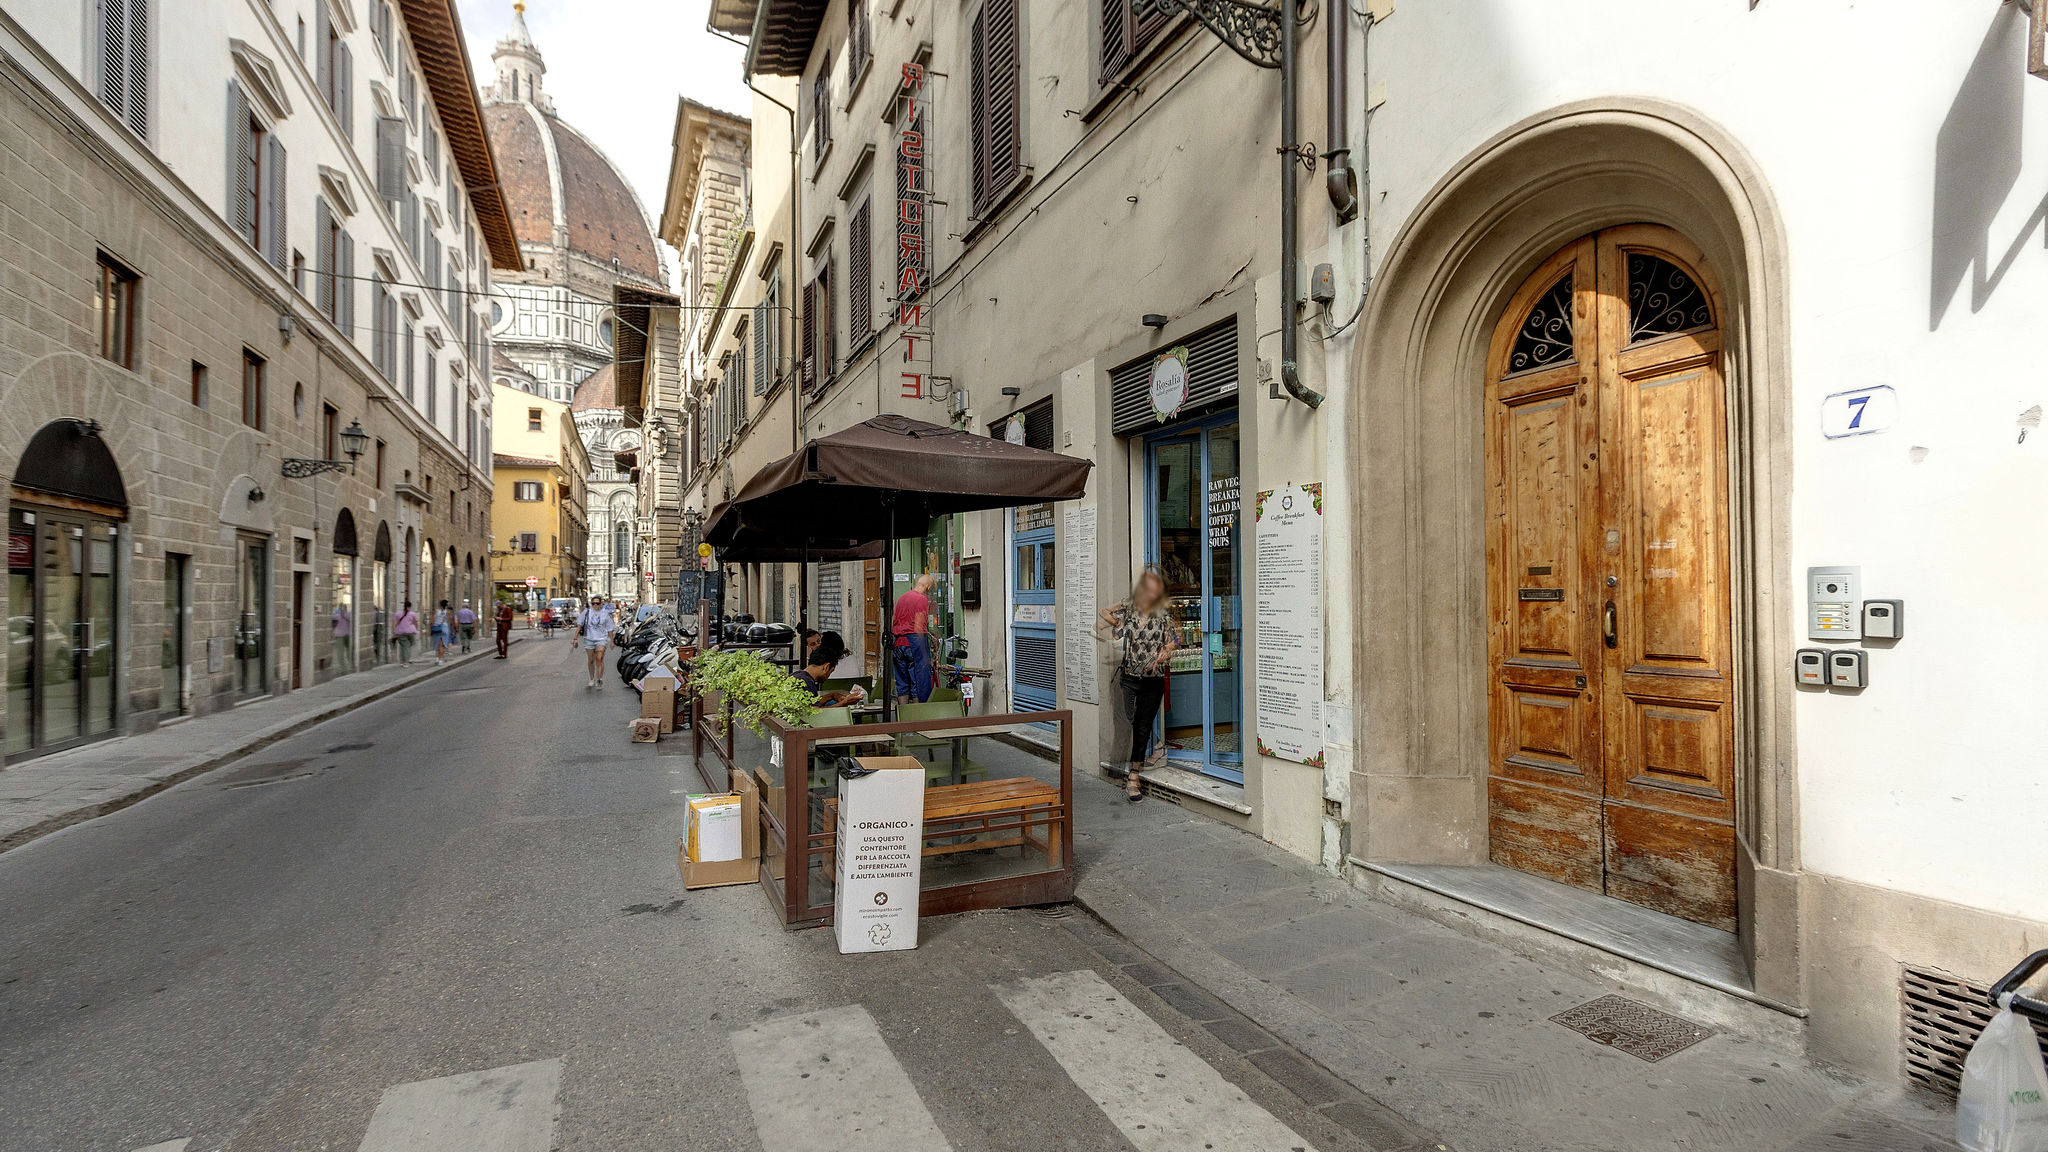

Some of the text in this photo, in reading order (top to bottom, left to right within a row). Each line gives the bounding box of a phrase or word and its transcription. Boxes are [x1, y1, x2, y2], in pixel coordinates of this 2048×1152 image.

[1156, 374, 1181, 390] Rosalia
[1848, 396, 1870, 429] 7
[1208, 476, 1240, 492] RAW VEG
[1208, 502, 1230, 514] SALAD
[1209, 514, 1234, 526] COFFEE
[1209, 526, 1229, 537] WRAP
[1209, 537, 1229, 547] SOUPS
[859, 821, 908, 829] ORGANICO
[878, 836, 904, 844] QUESTO
